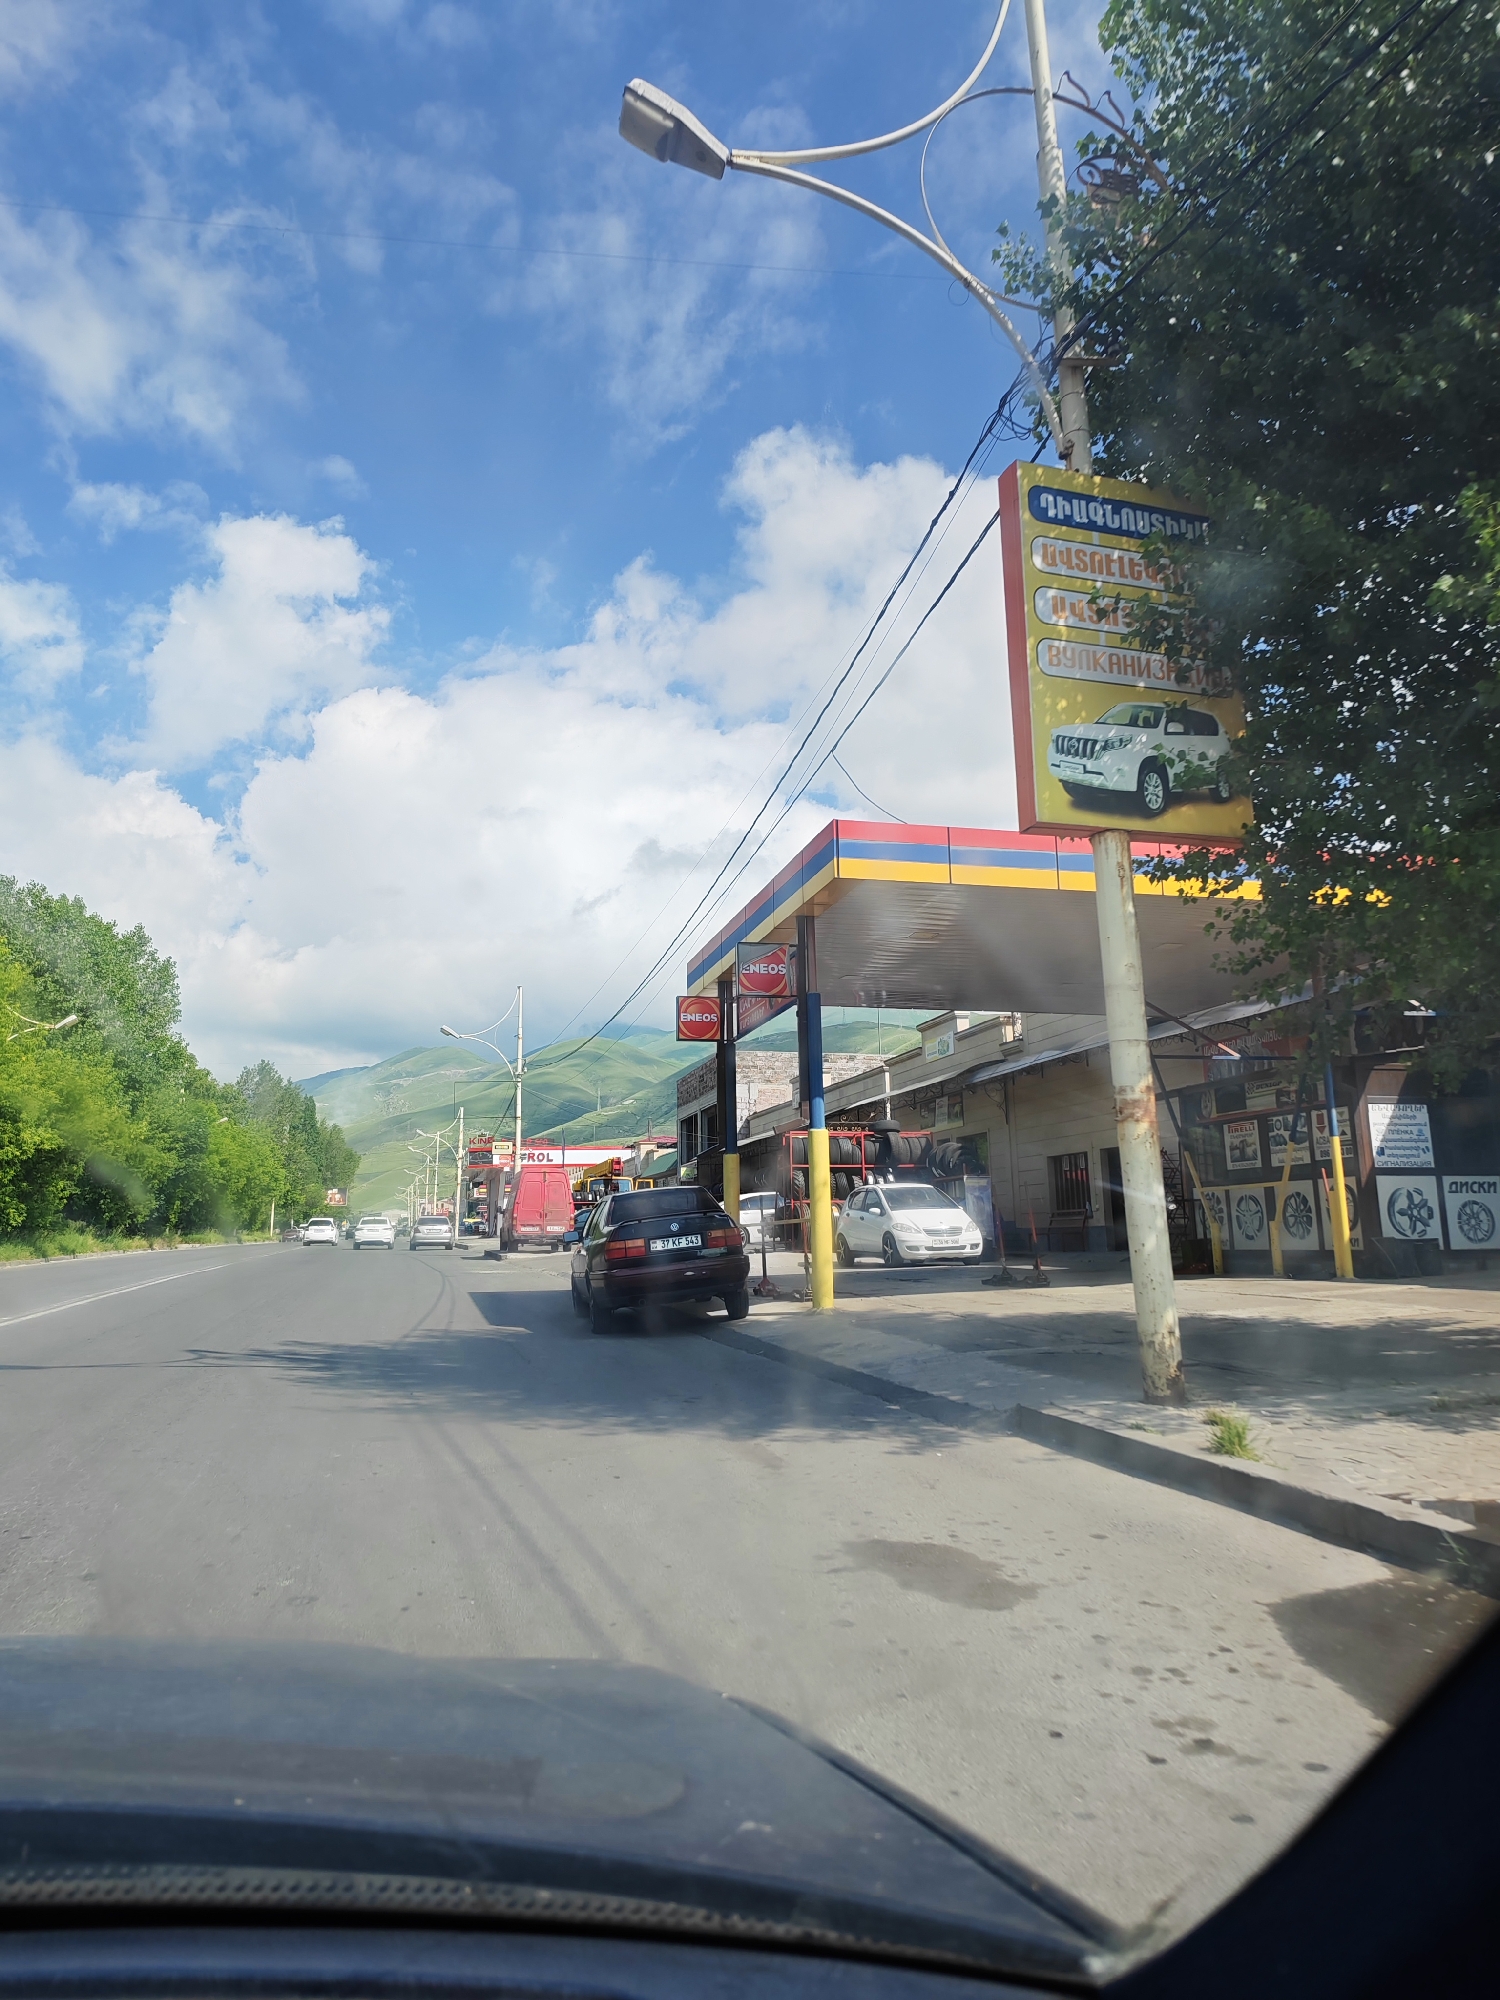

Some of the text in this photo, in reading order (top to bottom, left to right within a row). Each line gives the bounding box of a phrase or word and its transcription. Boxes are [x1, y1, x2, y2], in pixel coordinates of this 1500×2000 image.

[1042, 543, 1182, 588] ԱՎՏՈԷԼԵԿ
[741, 963, 787, 974] ENEOS
[681, 1013, 718, 1022] ENEOS
[1255, 1081, 1282, 1090] DUNLOP
[1228, 1122, 1255, 1133] PIRELLI
[1448, 1181, 1497, 1193] ДИСКИ
[661, 1240, 670, 1248] 37
[672, 1238, 683, 1247] KF
[685, 1236, 699, 1245] 543
